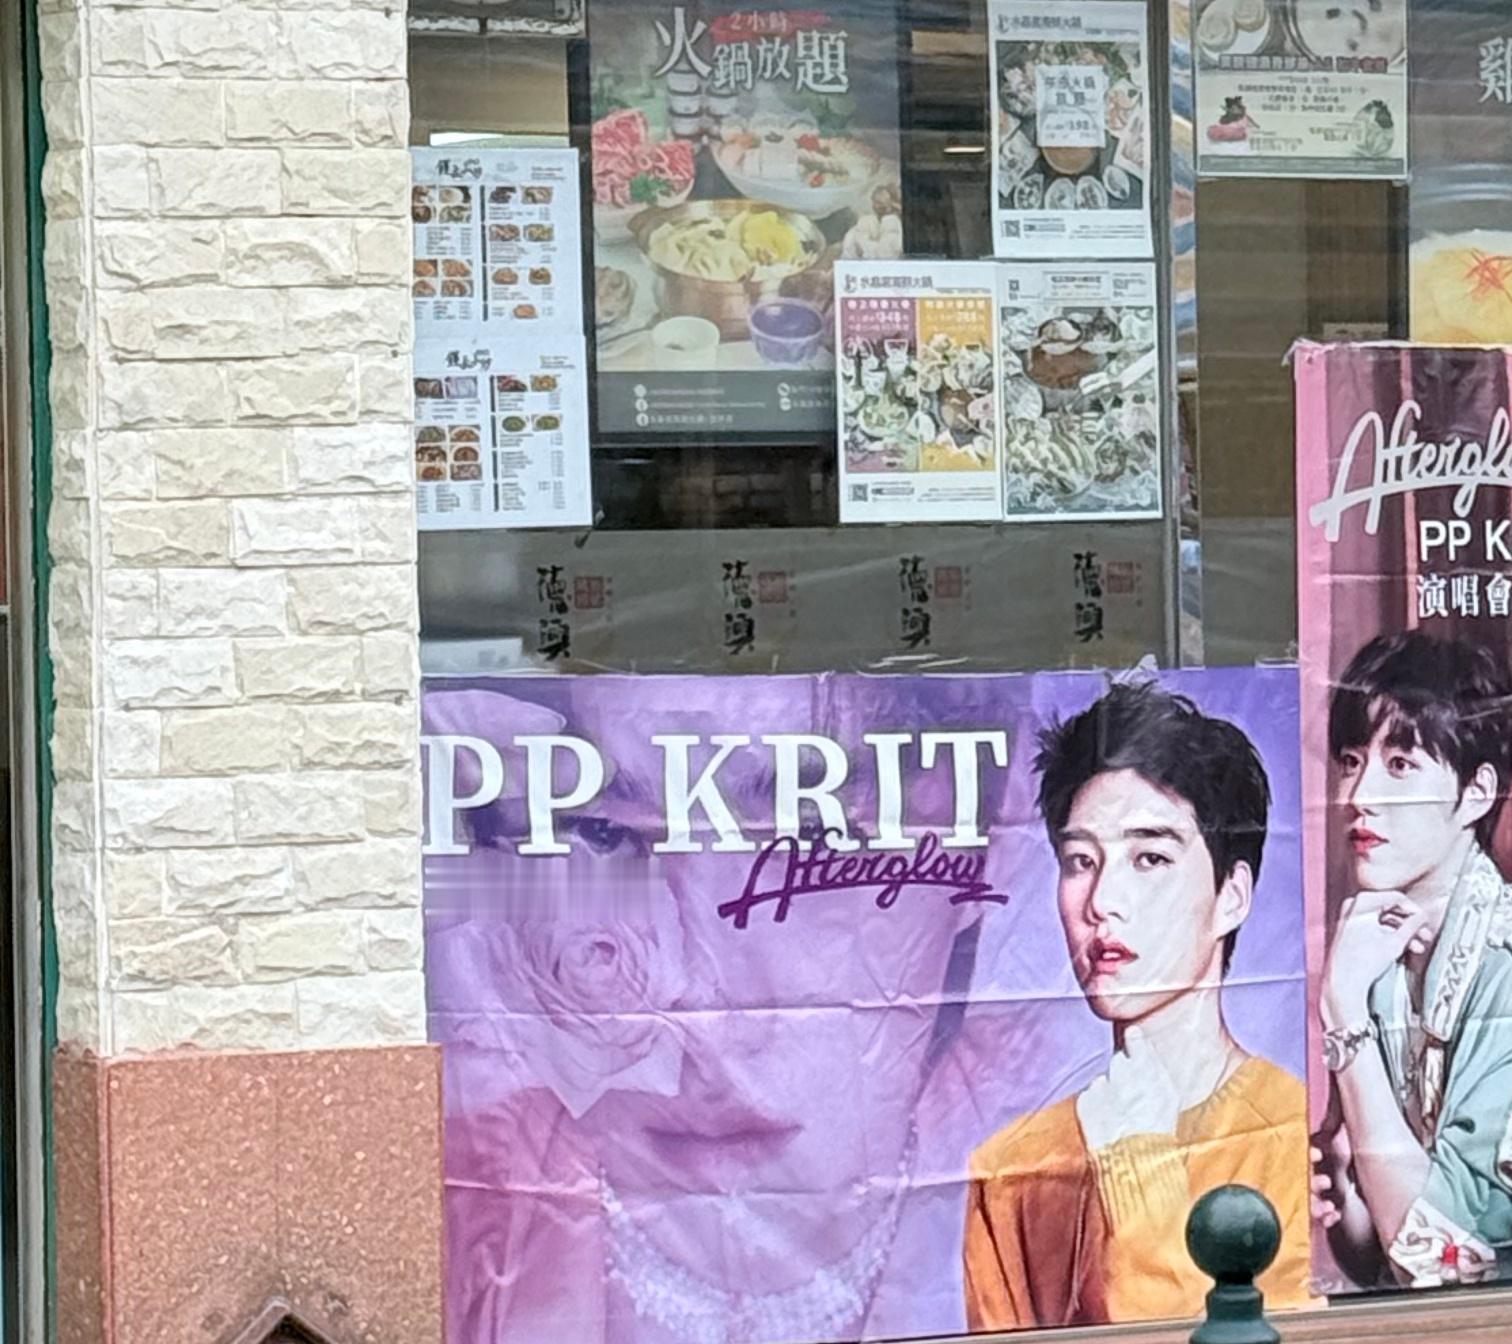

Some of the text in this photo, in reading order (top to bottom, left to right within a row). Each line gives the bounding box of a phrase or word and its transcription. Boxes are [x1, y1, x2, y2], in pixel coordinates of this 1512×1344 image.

[654, 6, 850, 94] 火鍋放題
[1419, 519, 1472, 562] PP
[419, 730, 1009, 856] PP KRIT
[716, 826, 1009, 930] Afterglow
